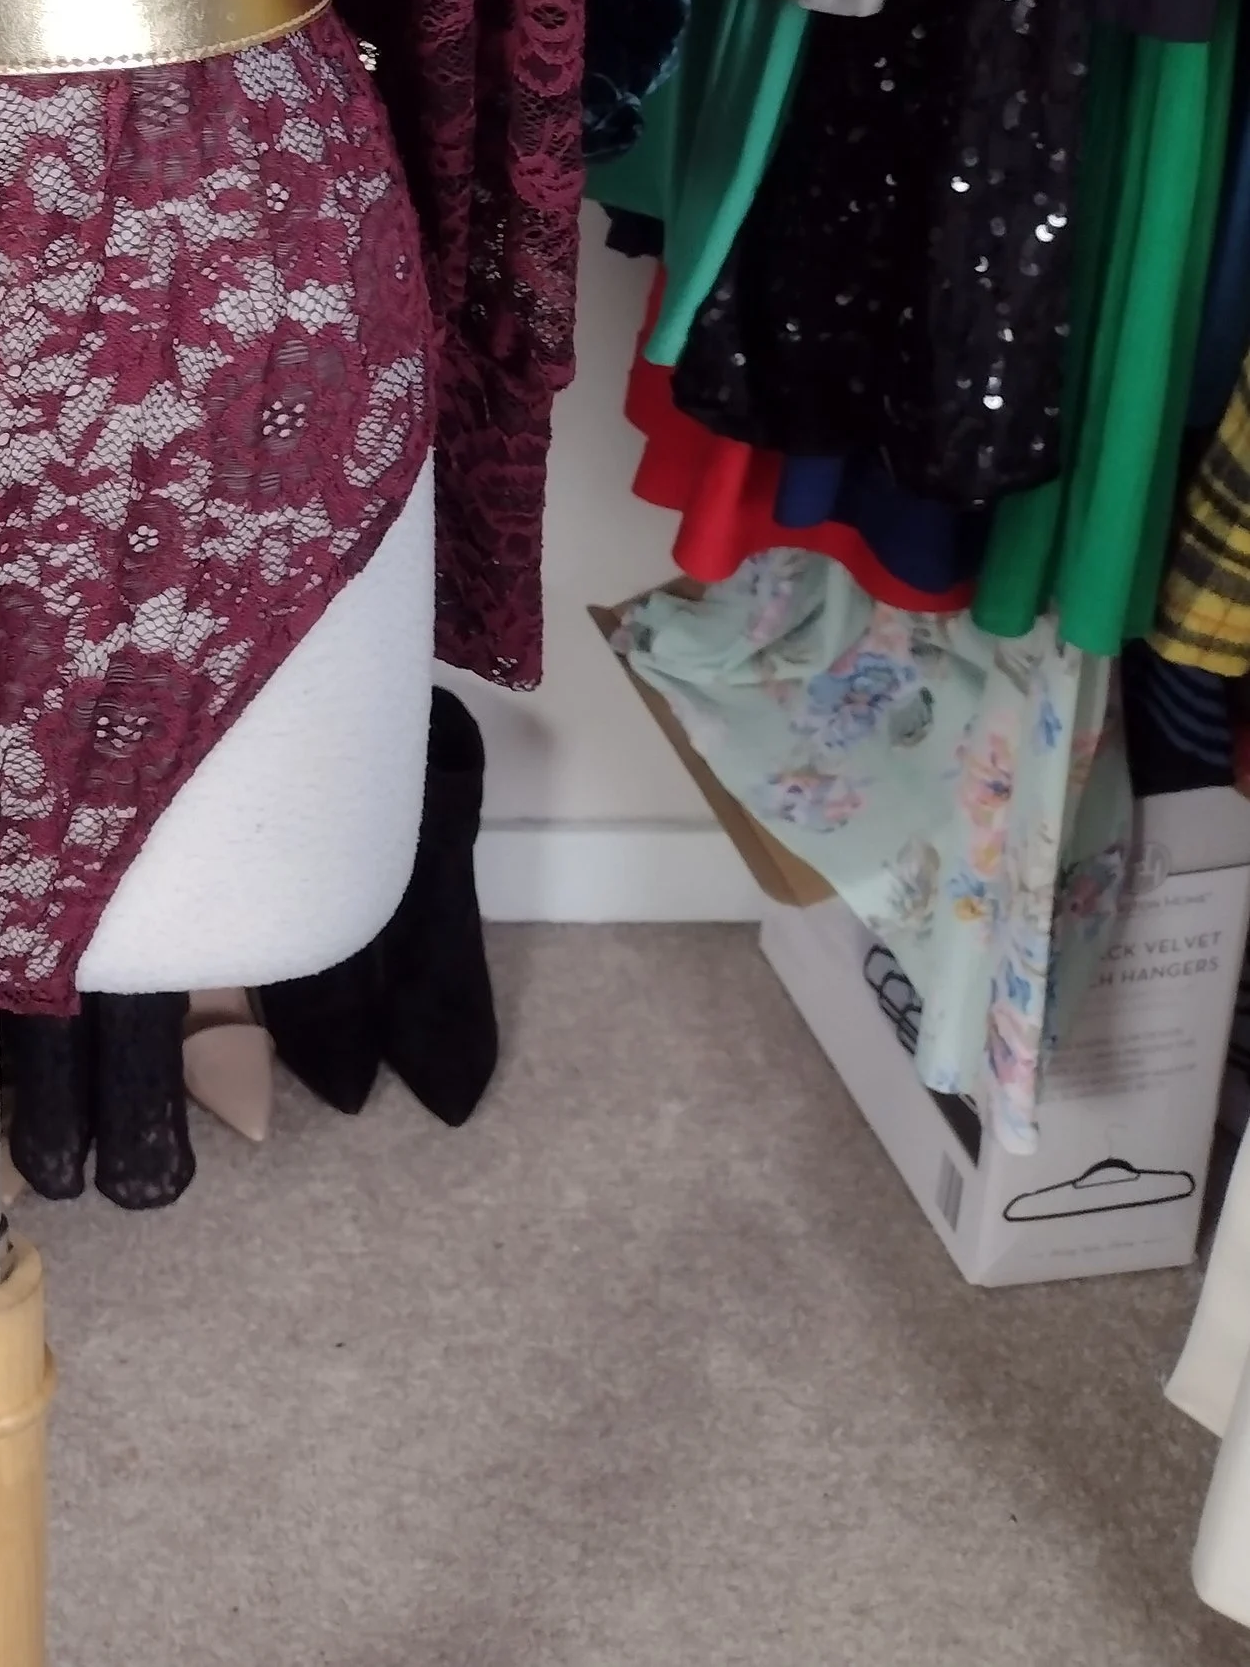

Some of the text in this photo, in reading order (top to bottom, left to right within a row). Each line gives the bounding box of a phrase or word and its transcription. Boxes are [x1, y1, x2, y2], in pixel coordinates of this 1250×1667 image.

[1101, 931, 1222, 961] CK VELVET
[1121, 956, 1219, 983] HANGERS
